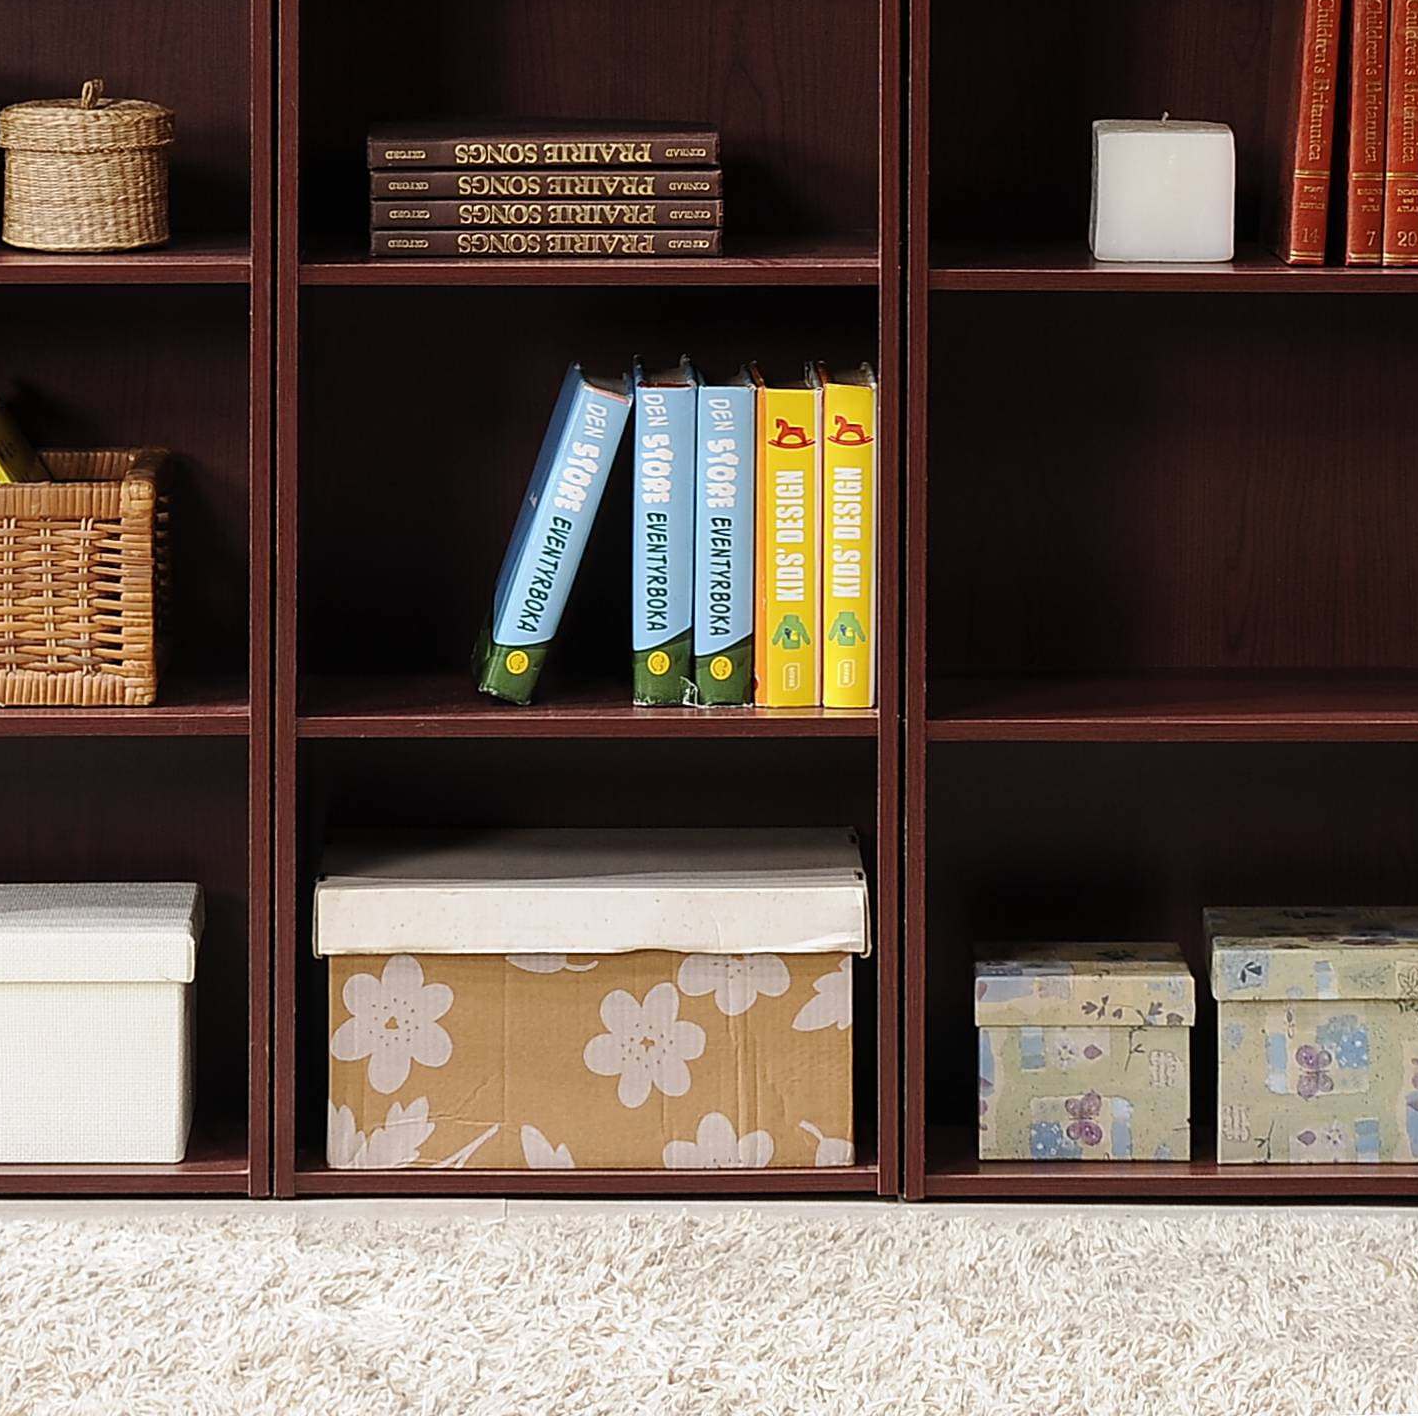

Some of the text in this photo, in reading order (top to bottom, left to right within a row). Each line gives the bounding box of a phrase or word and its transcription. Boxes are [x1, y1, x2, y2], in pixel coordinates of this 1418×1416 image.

[1308, 77, 1330, 161] Britannica
[454, 143, 538, 165] SONGS
[543, 143, 653, 164] PRAIRIE
[457, 175, 542, 196] SONGS
[546, 175, 656, 196] PRAIRIE
[458, 204, 543, 225] SONGS
[547, 204, 657, 225] PRAIRIE
[457, 233, 541, 254] SONGS
[546, 233, 656, 254] PRAIRIE
[1301, 228, 1320, 245] 14
[1366, 230, 1377, 247] 7
[1397, 230, 1418, 247] 20
[517, 403, 607, 633] DEN STORE EVENTYRBOKA
[641, 393, 676, 632] DEN STORE EVENTYRBOKA
[705, 398, 740, 637] DEN STORE EVENTYRBOKA
[775, 469, 806, 602] KIDS' DESIGN
[832, 466, 863, 599] KIDS' DESIGN
